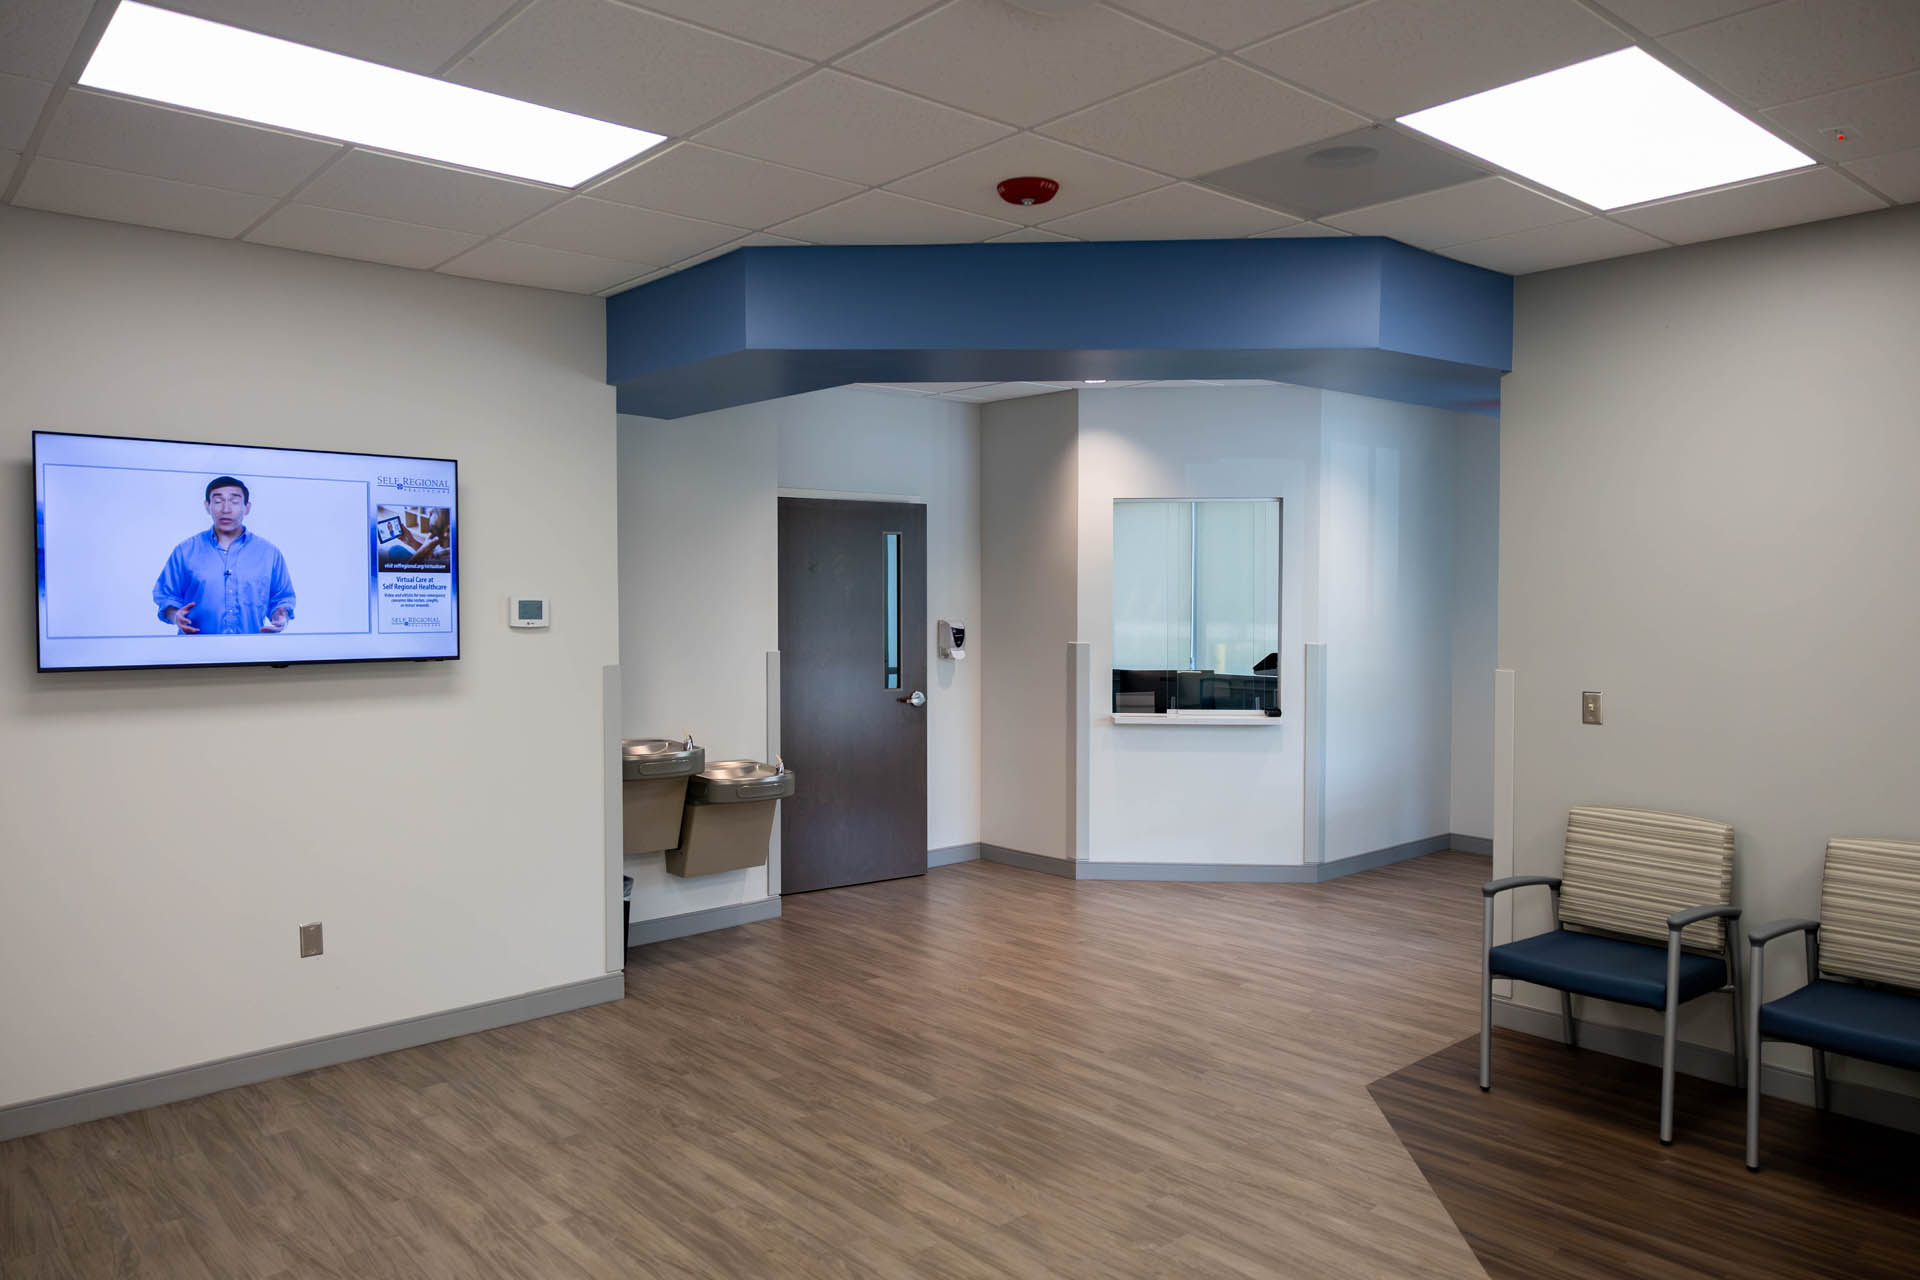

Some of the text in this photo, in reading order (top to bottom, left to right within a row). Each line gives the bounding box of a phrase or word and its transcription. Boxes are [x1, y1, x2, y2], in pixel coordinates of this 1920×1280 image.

[1040, 181, 1056, 191] FIRE
[377, 475, 448, 487] SELF REGIONAL
[394, 583, 417, 591] Regional
